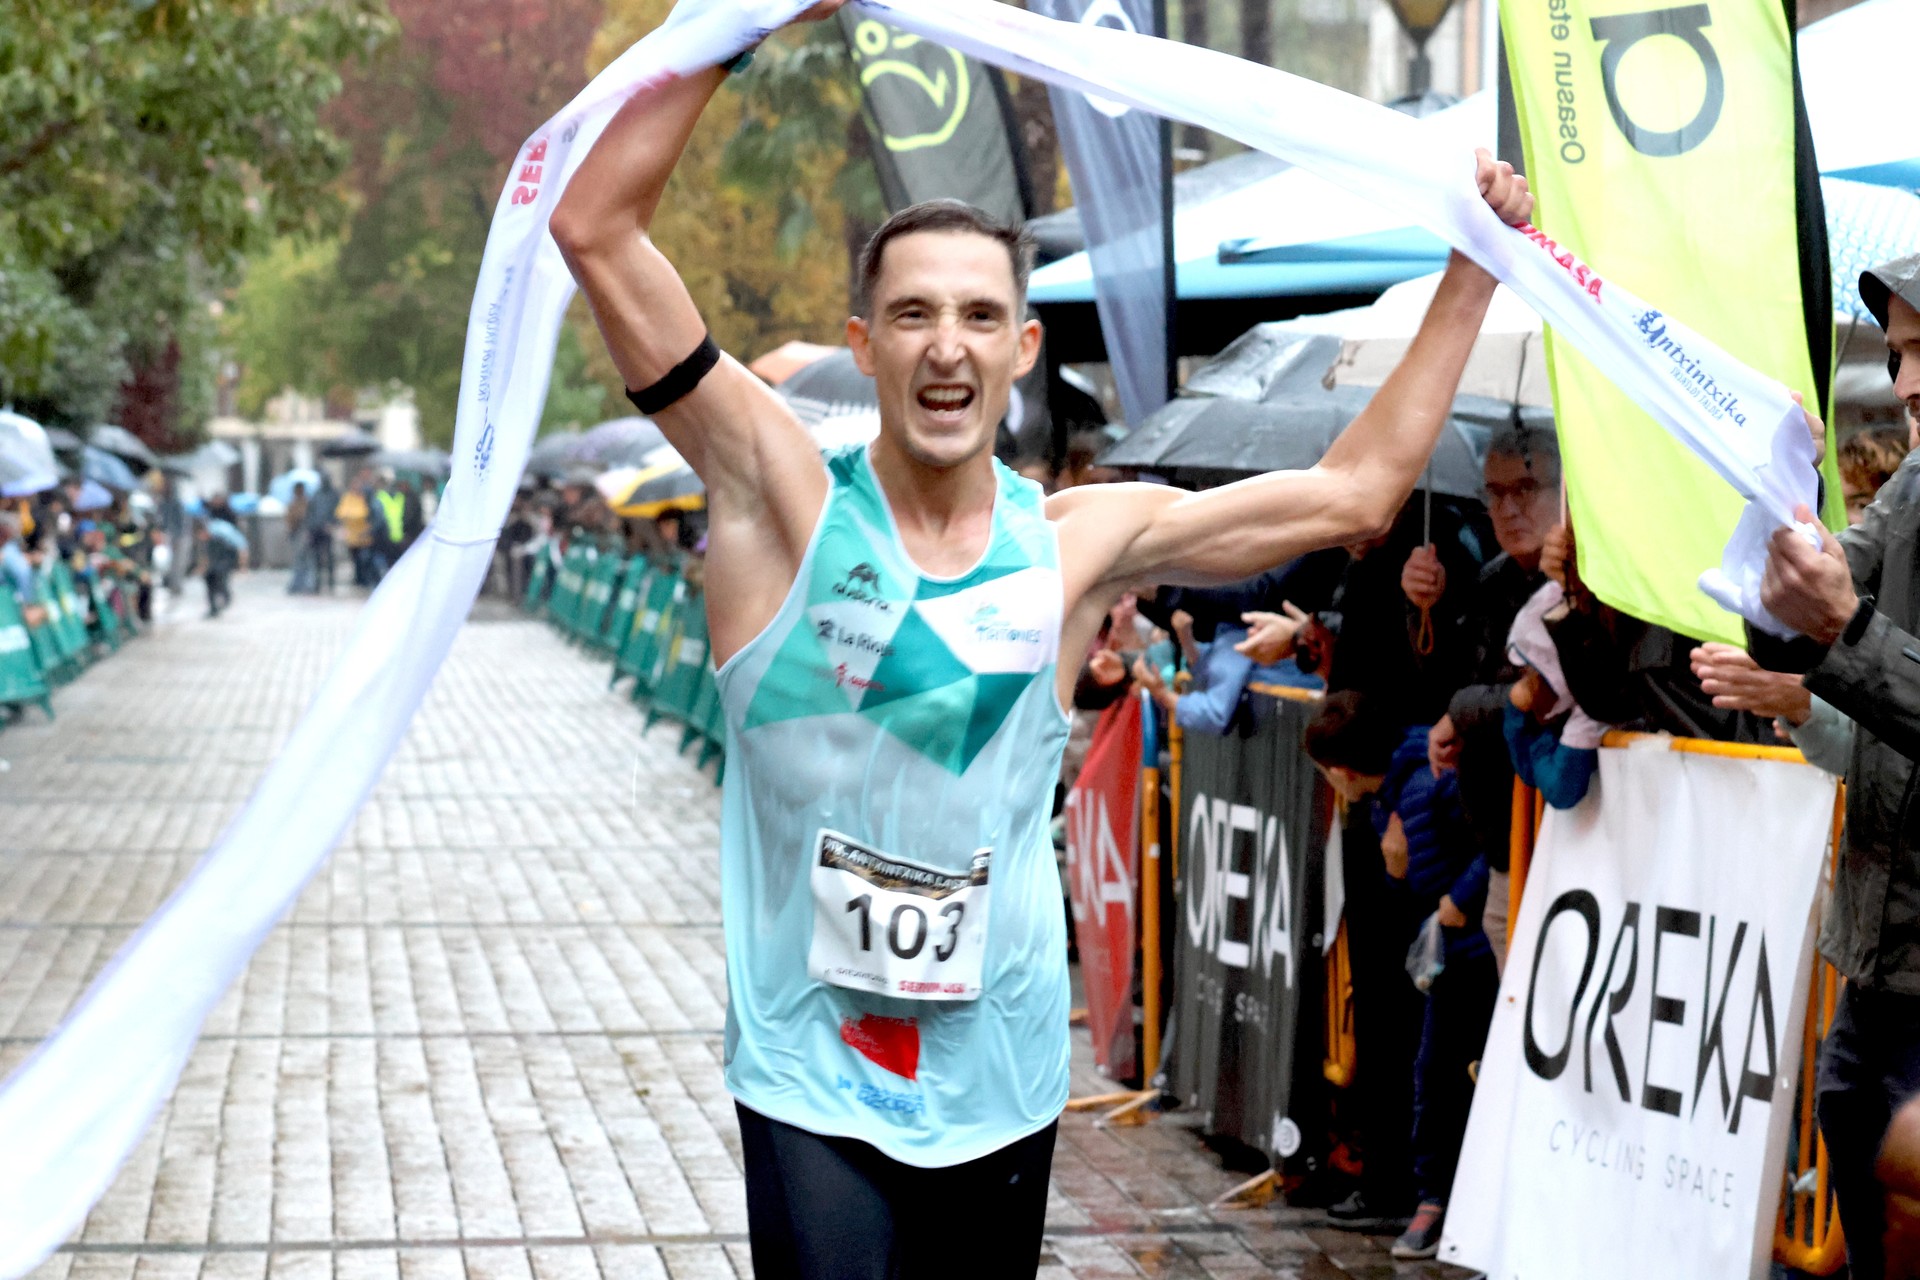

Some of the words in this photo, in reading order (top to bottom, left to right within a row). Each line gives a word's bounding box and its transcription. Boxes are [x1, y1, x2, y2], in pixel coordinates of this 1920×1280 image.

[846, 893, 965, 962] 103
[1523, 888, 1778, 1135] OREKA
[1549, 1119, 1646, 1181] CYCLING
[1665, 1153, 1735, 1208] SPACE
